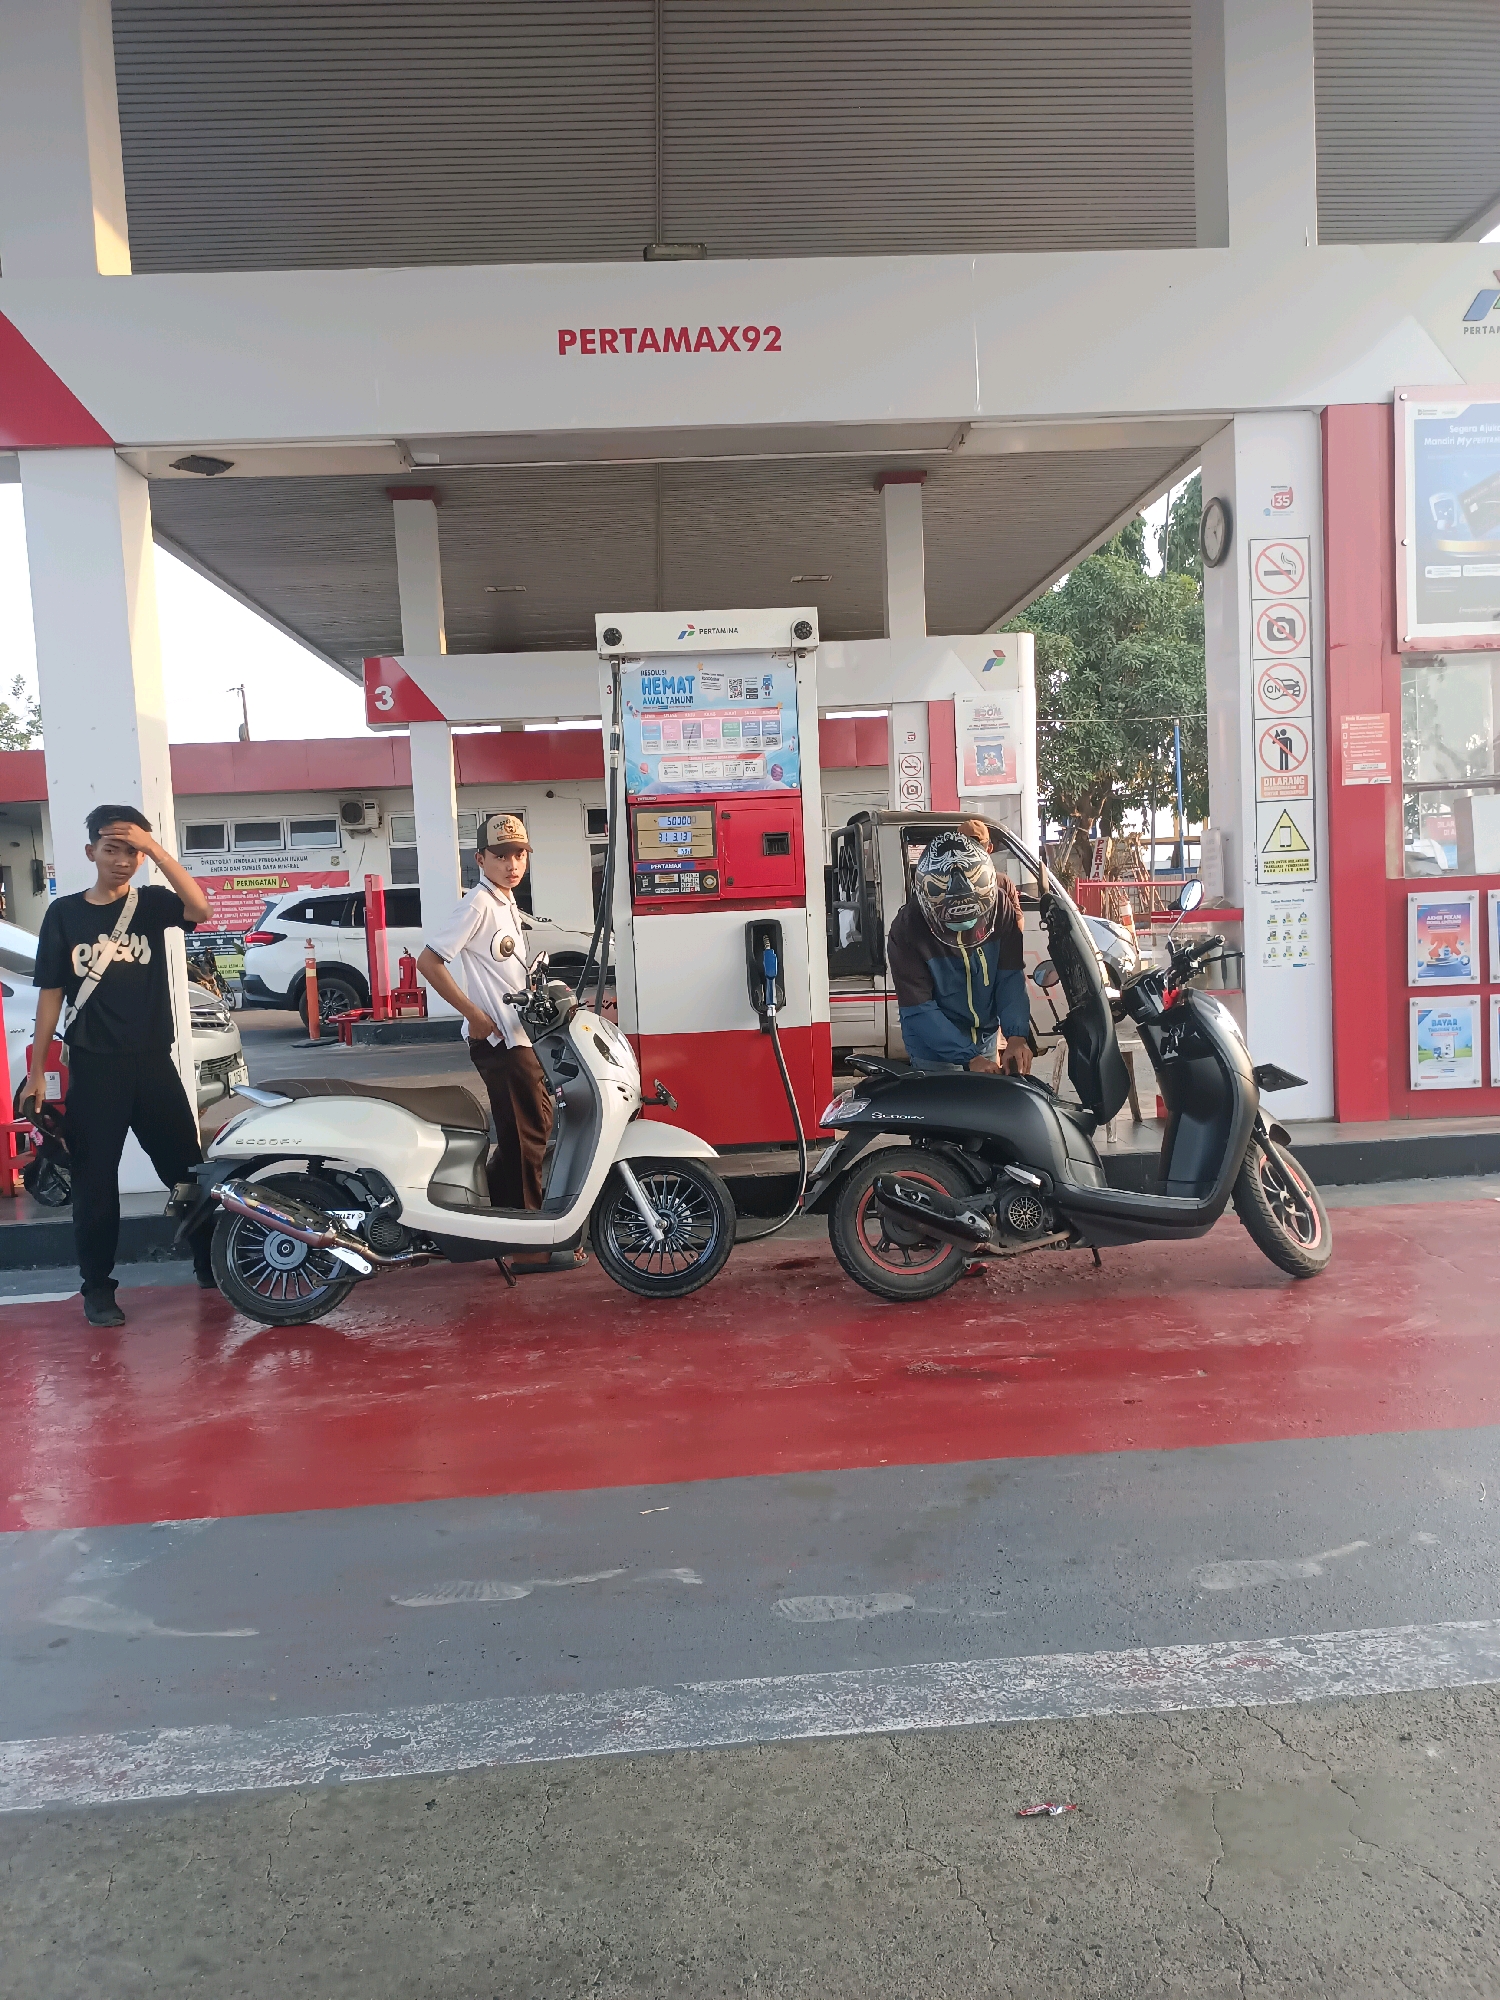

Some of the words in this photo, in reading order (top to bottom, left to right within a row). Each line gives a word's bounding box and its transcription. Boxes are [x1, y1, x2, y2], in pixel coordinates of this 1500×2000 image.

[558, 325, 782, 355] PERTAMAX92
[1450, 424, 1478, 435] Segera
[1424, 436, 1455, 446] Mandiri
[698, 627, 739, 635] PERTAMINA
[640, 669, 667, 677] RESOLUSI
[606, 684, 613, 695] 3
[641, 675, 696, 695] HEMAT
[1266, 684, 1281, 694] ON
[373, 685, 395, 711] 3
[642, 696, 665, 705] AWAL
[1263, 776, 1305, 786] DILARANG
[1092, 839, 1104, 882] PERTA
[650, 862, 682, 870] PERTAMAX
[236, 879, 277, 887] PERINGATAN
[1431, 1018, 1458, 1027] BAYAR
